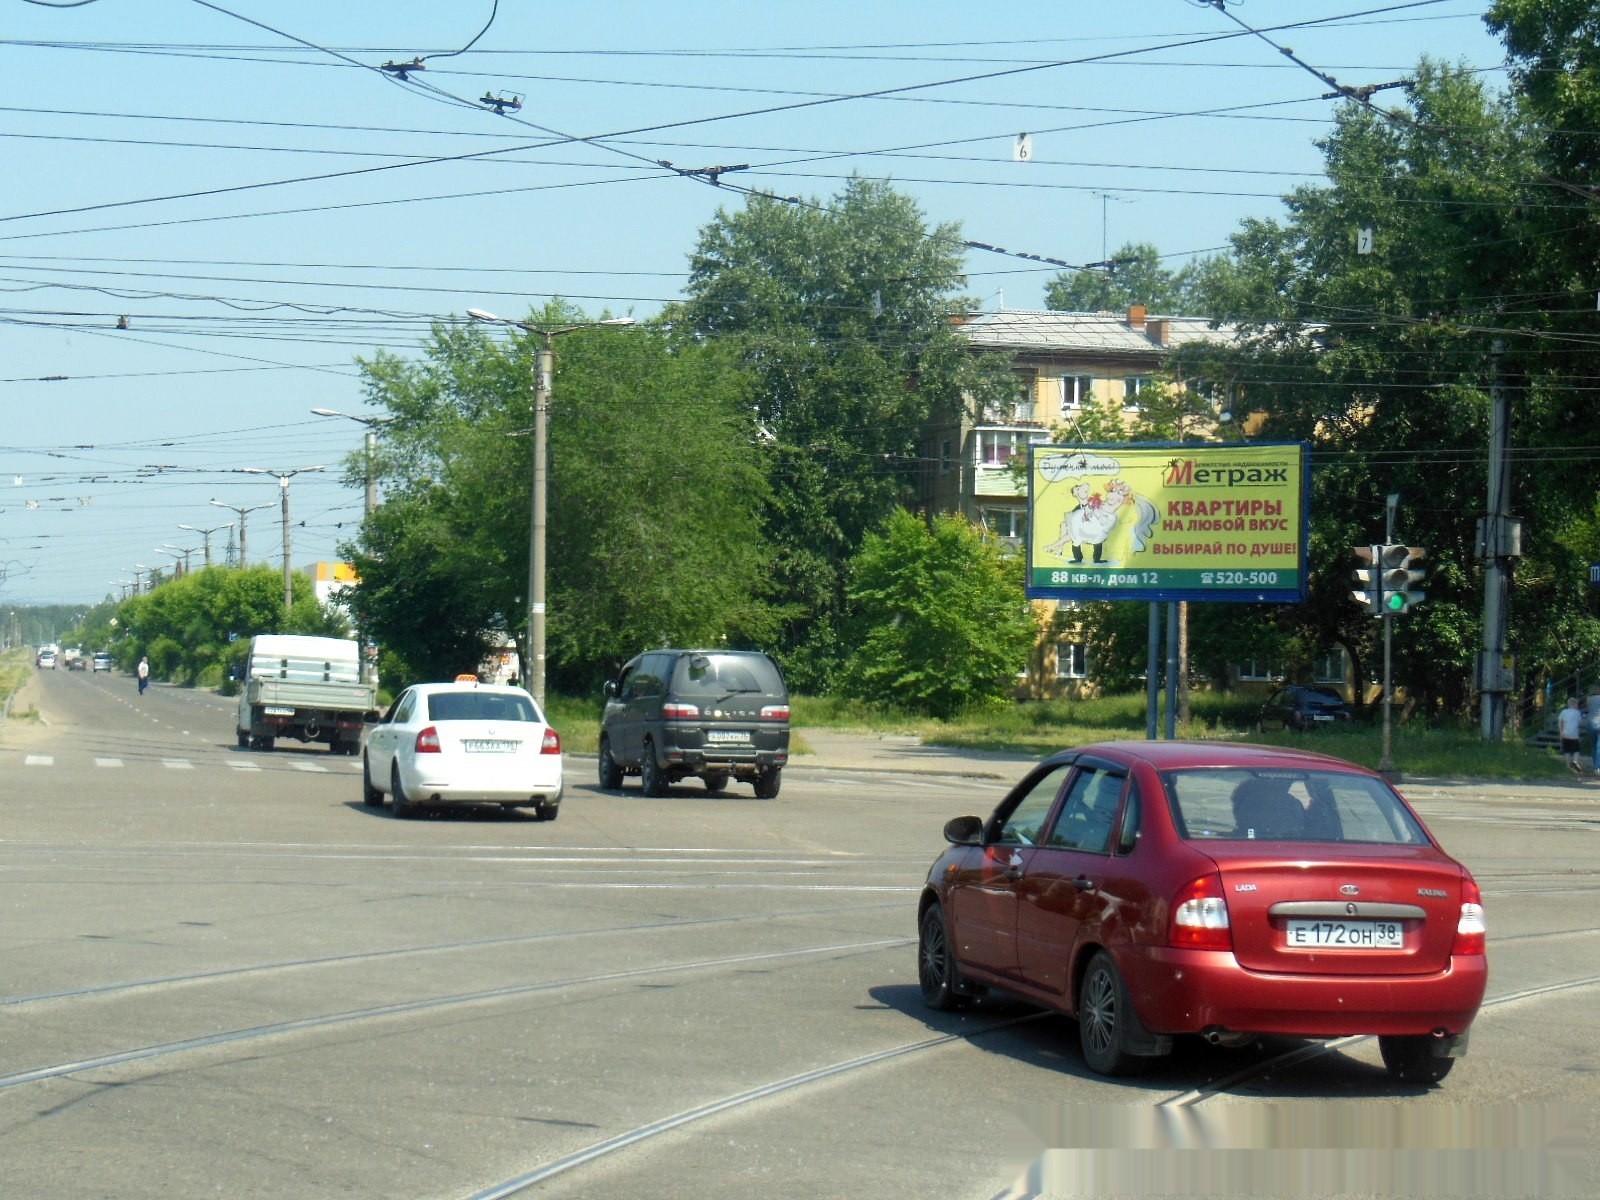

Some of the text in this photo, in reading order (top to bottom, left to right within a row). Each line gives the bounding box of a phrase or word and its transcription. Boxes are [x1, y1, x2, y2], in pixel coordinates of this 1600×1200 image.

[1019, 144, 1027, 158] 6
[1361, 237, 1368, 249] 7
[1166, 459, 1288, 487] Метраж
[1167, 500, 1282, 516] КВАРТИРЫ
[1162, 516, 1289, 532] НА ЛЮБОЙ ВКУС
[1153, 541, 1297, 557] ВЫБИРАЙ ПО ДУШЕ!
[1051, 571, 1158, 585] 88 кв-л, дом 12
[1216, 572, 1277, 584] 520-500
[1235, 884, 1257, 892] LADA
[1417, 888, 1448, 898] KALINA
[1377, 924, 1396, 939] 38
